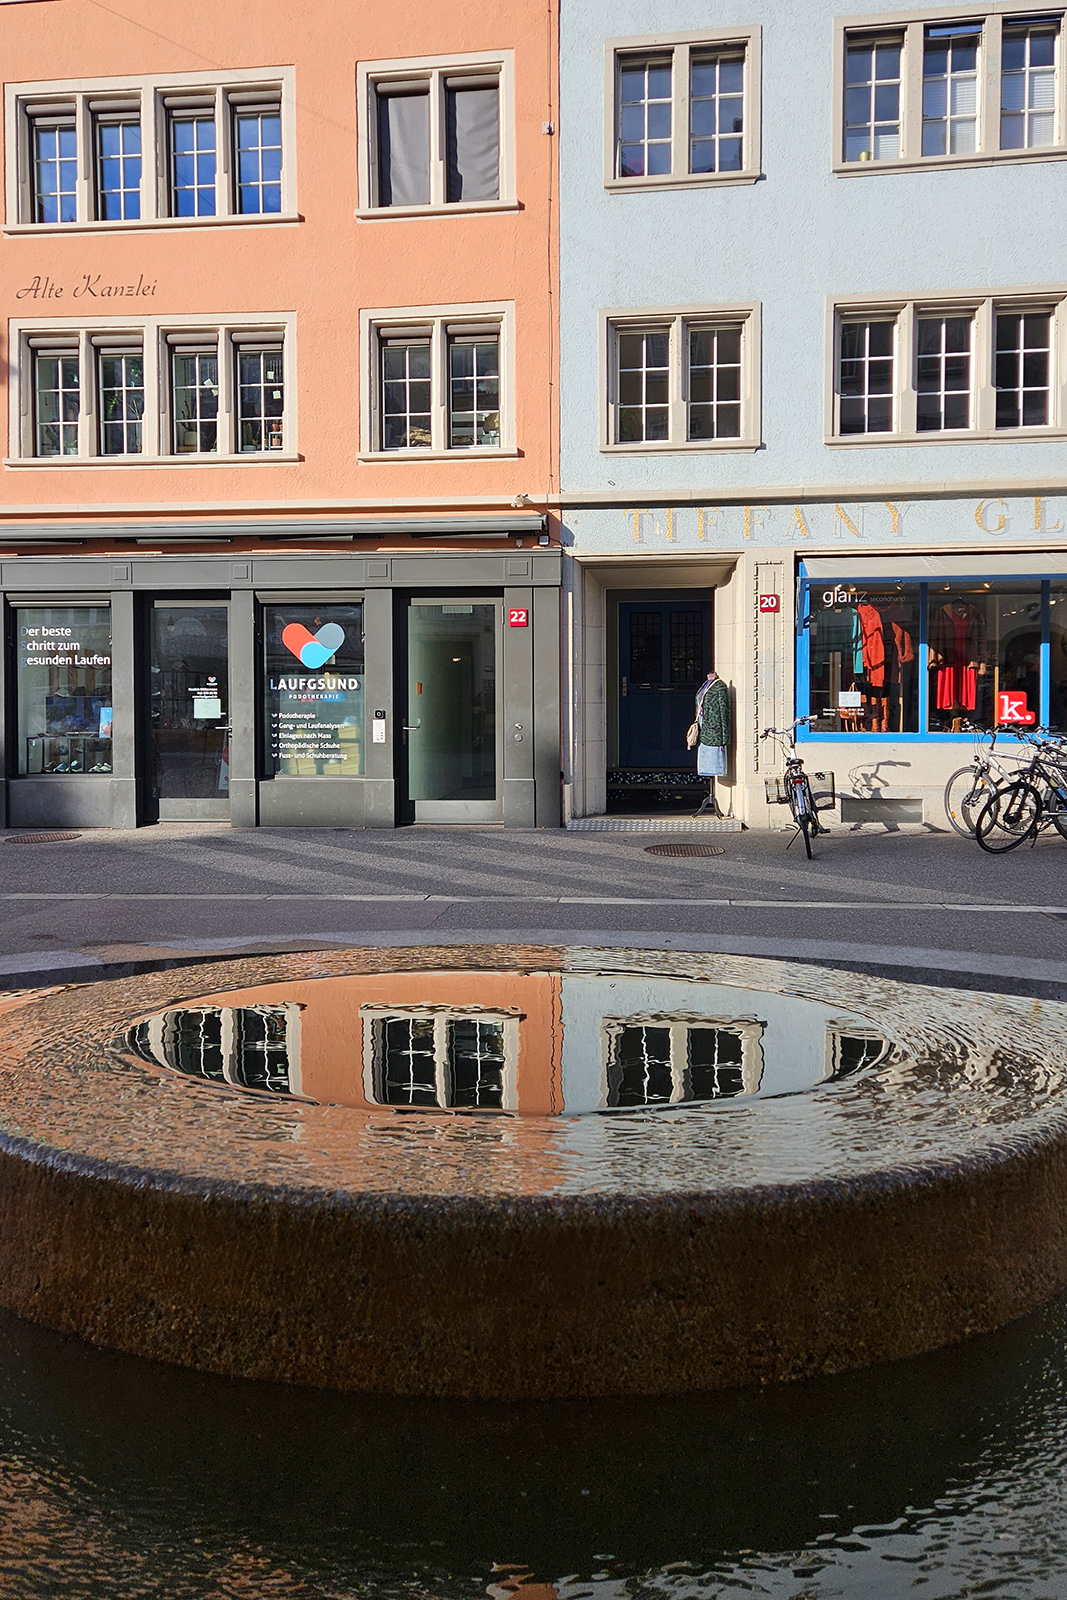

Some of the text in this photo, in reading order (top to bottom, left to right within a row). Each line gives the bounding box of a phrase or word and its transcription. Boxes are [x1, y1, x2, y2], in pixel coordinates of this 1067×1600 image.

[16, 274, 157, 299] Alte Kanzlei
[622, 500, 907, 541] TIFFANY
[760, 596, 777, 608] 20
[822, 586, 868, 608] glanz
[510, 611, 526, 622] 22
[20, 626, 71, 636] Der beste
[20, 640, 80, 651] Schritt zum
[20, 654, 111, 667] gesunden Laufen
[270, 678, 358, 690] LAUFGSUND
[1000, 695, 1032, 721] k.
